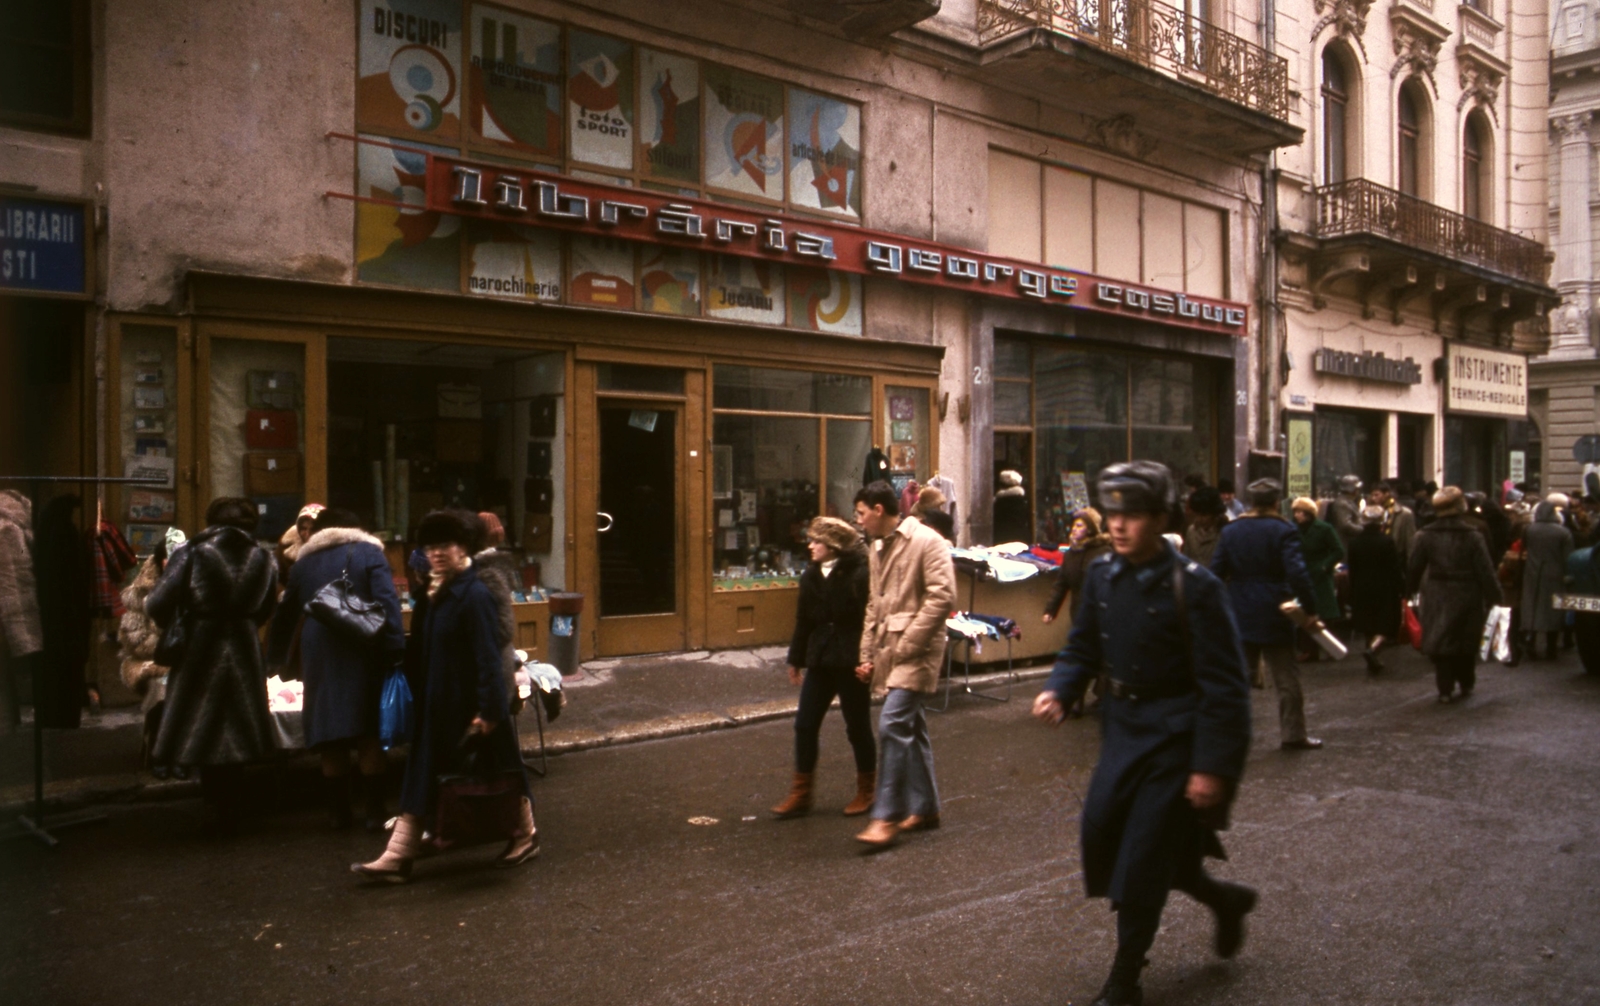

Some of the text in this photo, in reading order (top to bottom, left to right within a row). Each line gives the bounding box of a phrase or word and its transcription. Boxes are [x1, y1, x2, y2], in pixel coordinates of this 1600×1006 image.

[374, 7, 447, 49] DISCURI
[579, 104, 624, 127] foto
[577, 119, 628, 138] SPORT
[867, 240, 1078, 299] george
[468, 275, 559, 297] marochinerie
[1454, 355, 1523, 387] INSTRUMENTE
[1451, 386, 1526, 407] TEHNICE-MEDICALE
